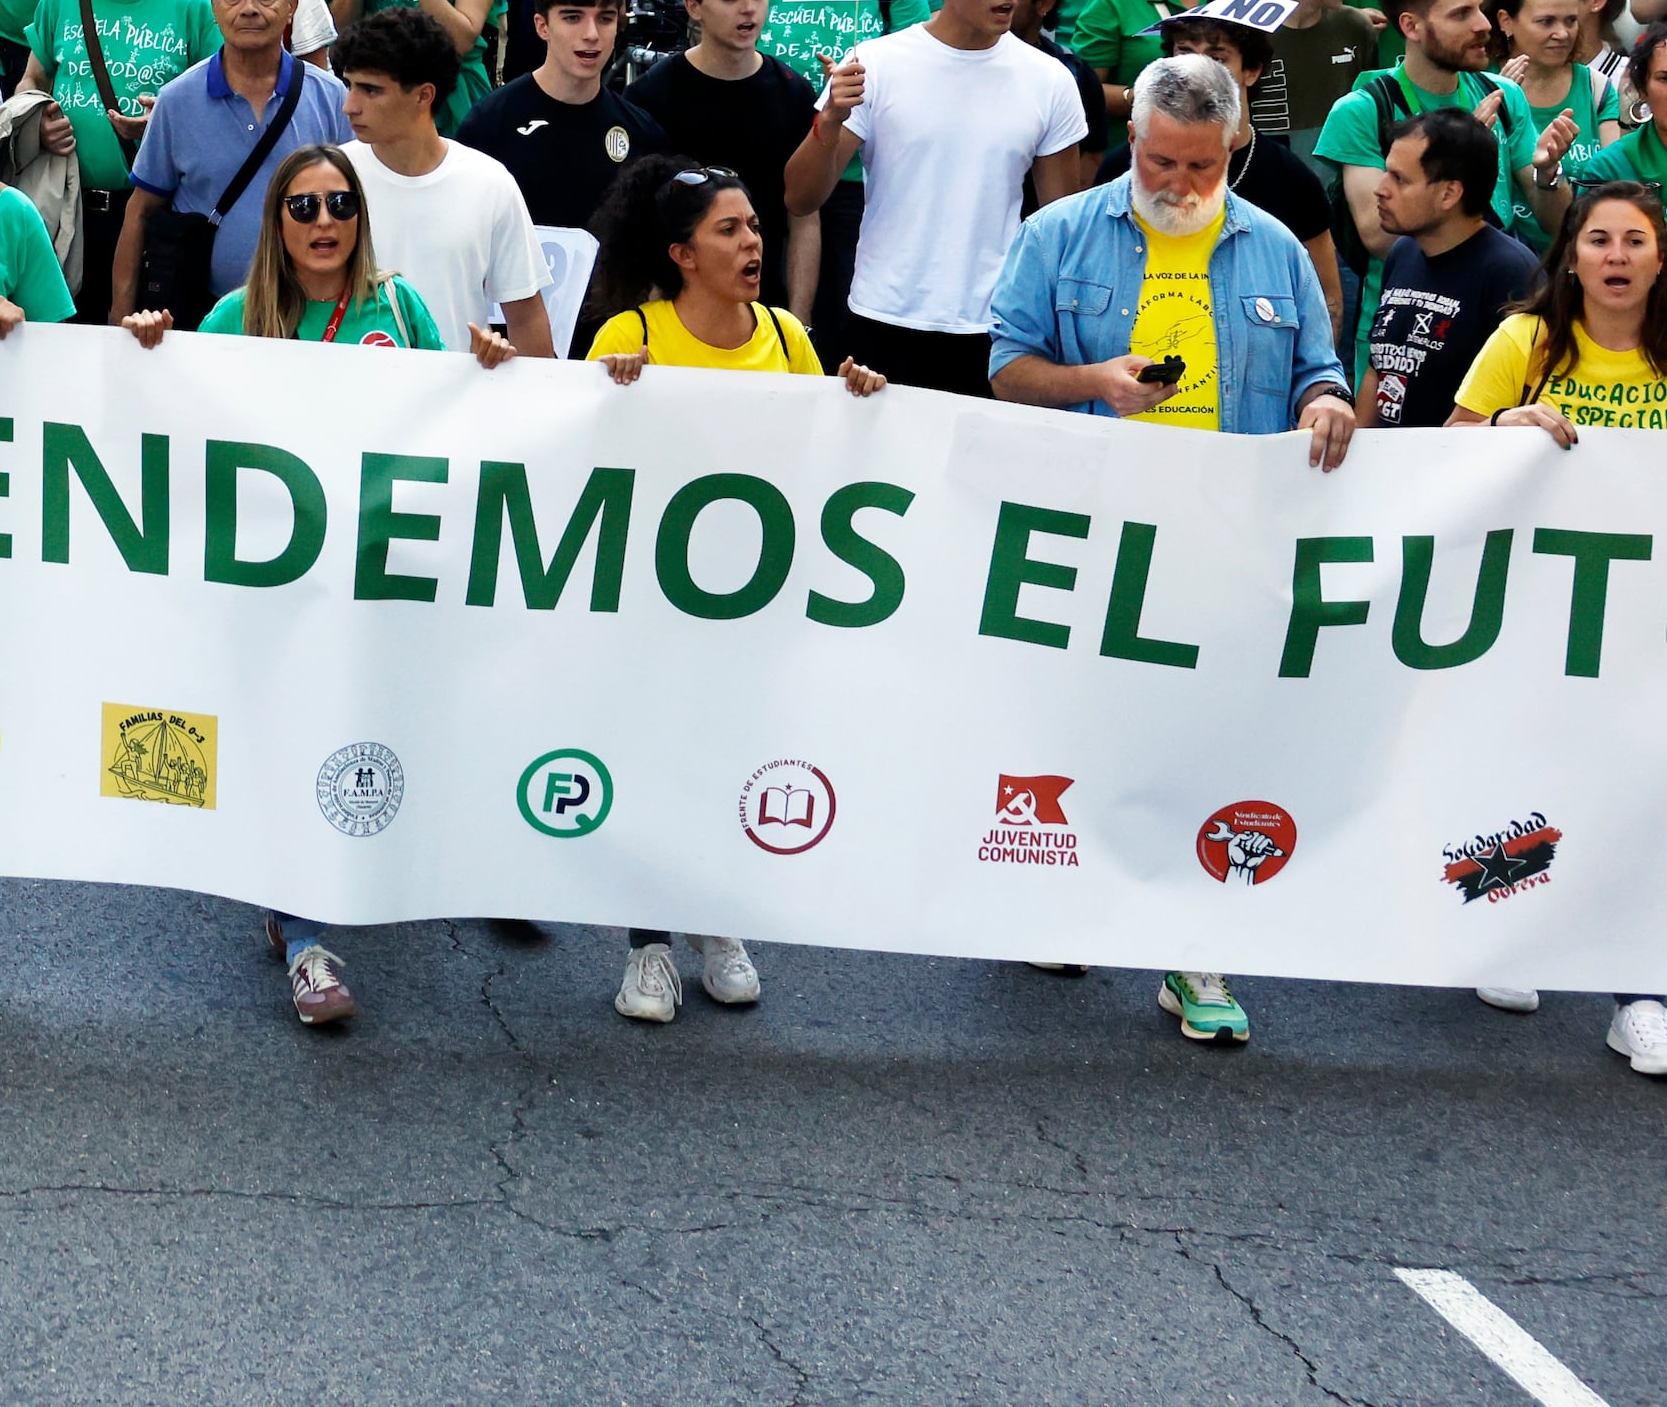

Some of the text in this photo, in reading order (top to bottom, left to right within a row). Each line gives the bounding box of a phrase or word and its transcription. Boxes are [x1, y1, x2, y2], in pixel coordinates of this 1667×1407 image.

[1159, 405, 1214, 415] EDUCACIÓN
[979, 502, 1198, 668] EL
[1279, 528, 1652, 678] FUT
[119, 712, 163, 731] FAMILIAS
[169, 715, 186, 729] DEL
[739, 759, 813, 828] FRENTE DE ESTUDIANTES
[982, 830, 1077, 849] JUVENTUD
[1441, 811, 1548, 863] Solidaridad
[977, 847, 1079, 868] COMUNISTA
